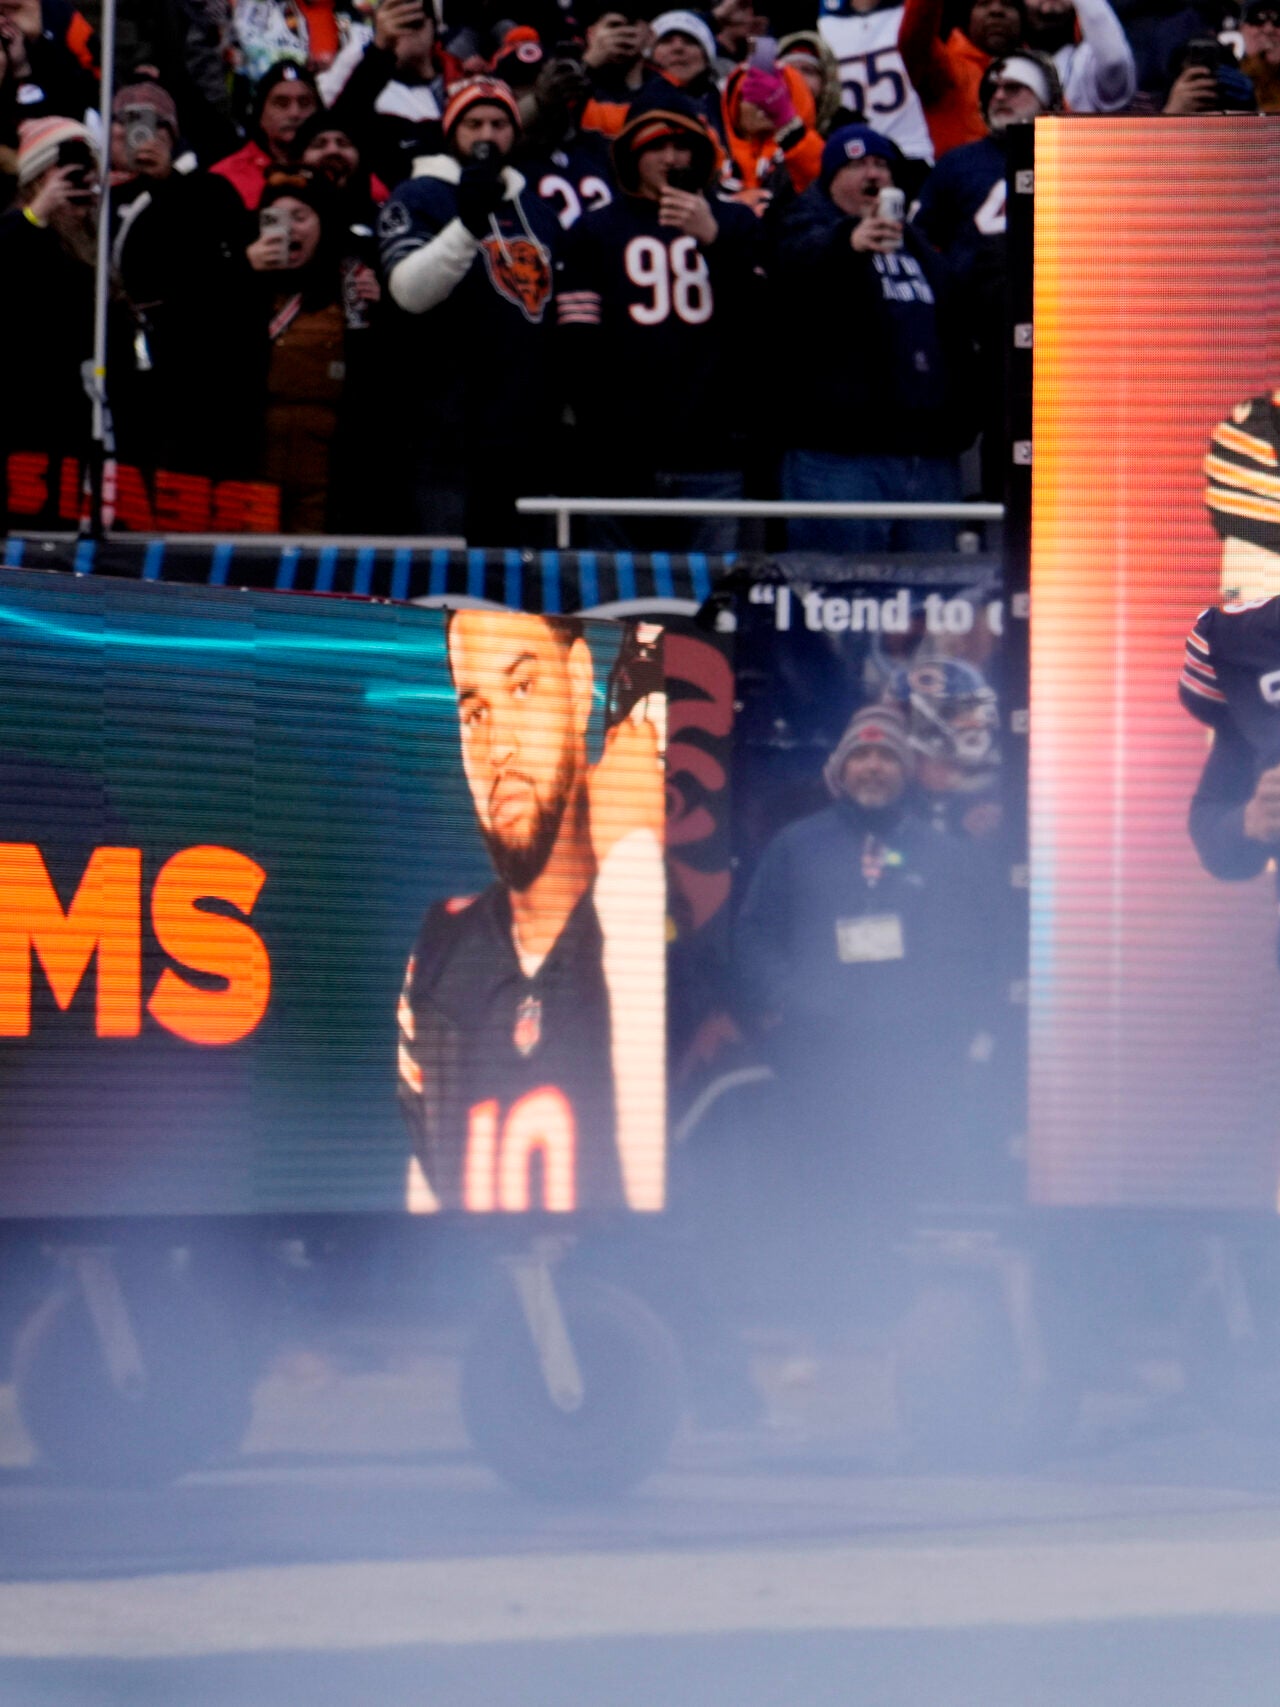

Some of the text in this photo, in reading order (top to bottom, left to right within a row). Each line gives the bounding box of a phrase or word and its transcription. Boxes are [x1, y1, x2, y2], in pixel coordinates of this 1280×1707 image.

[623, 234, 715, 326] 98
[804, 588, 912, 633] tend
[923, 593, 974, 633] to
[0, 842, 271, 1046] MS
